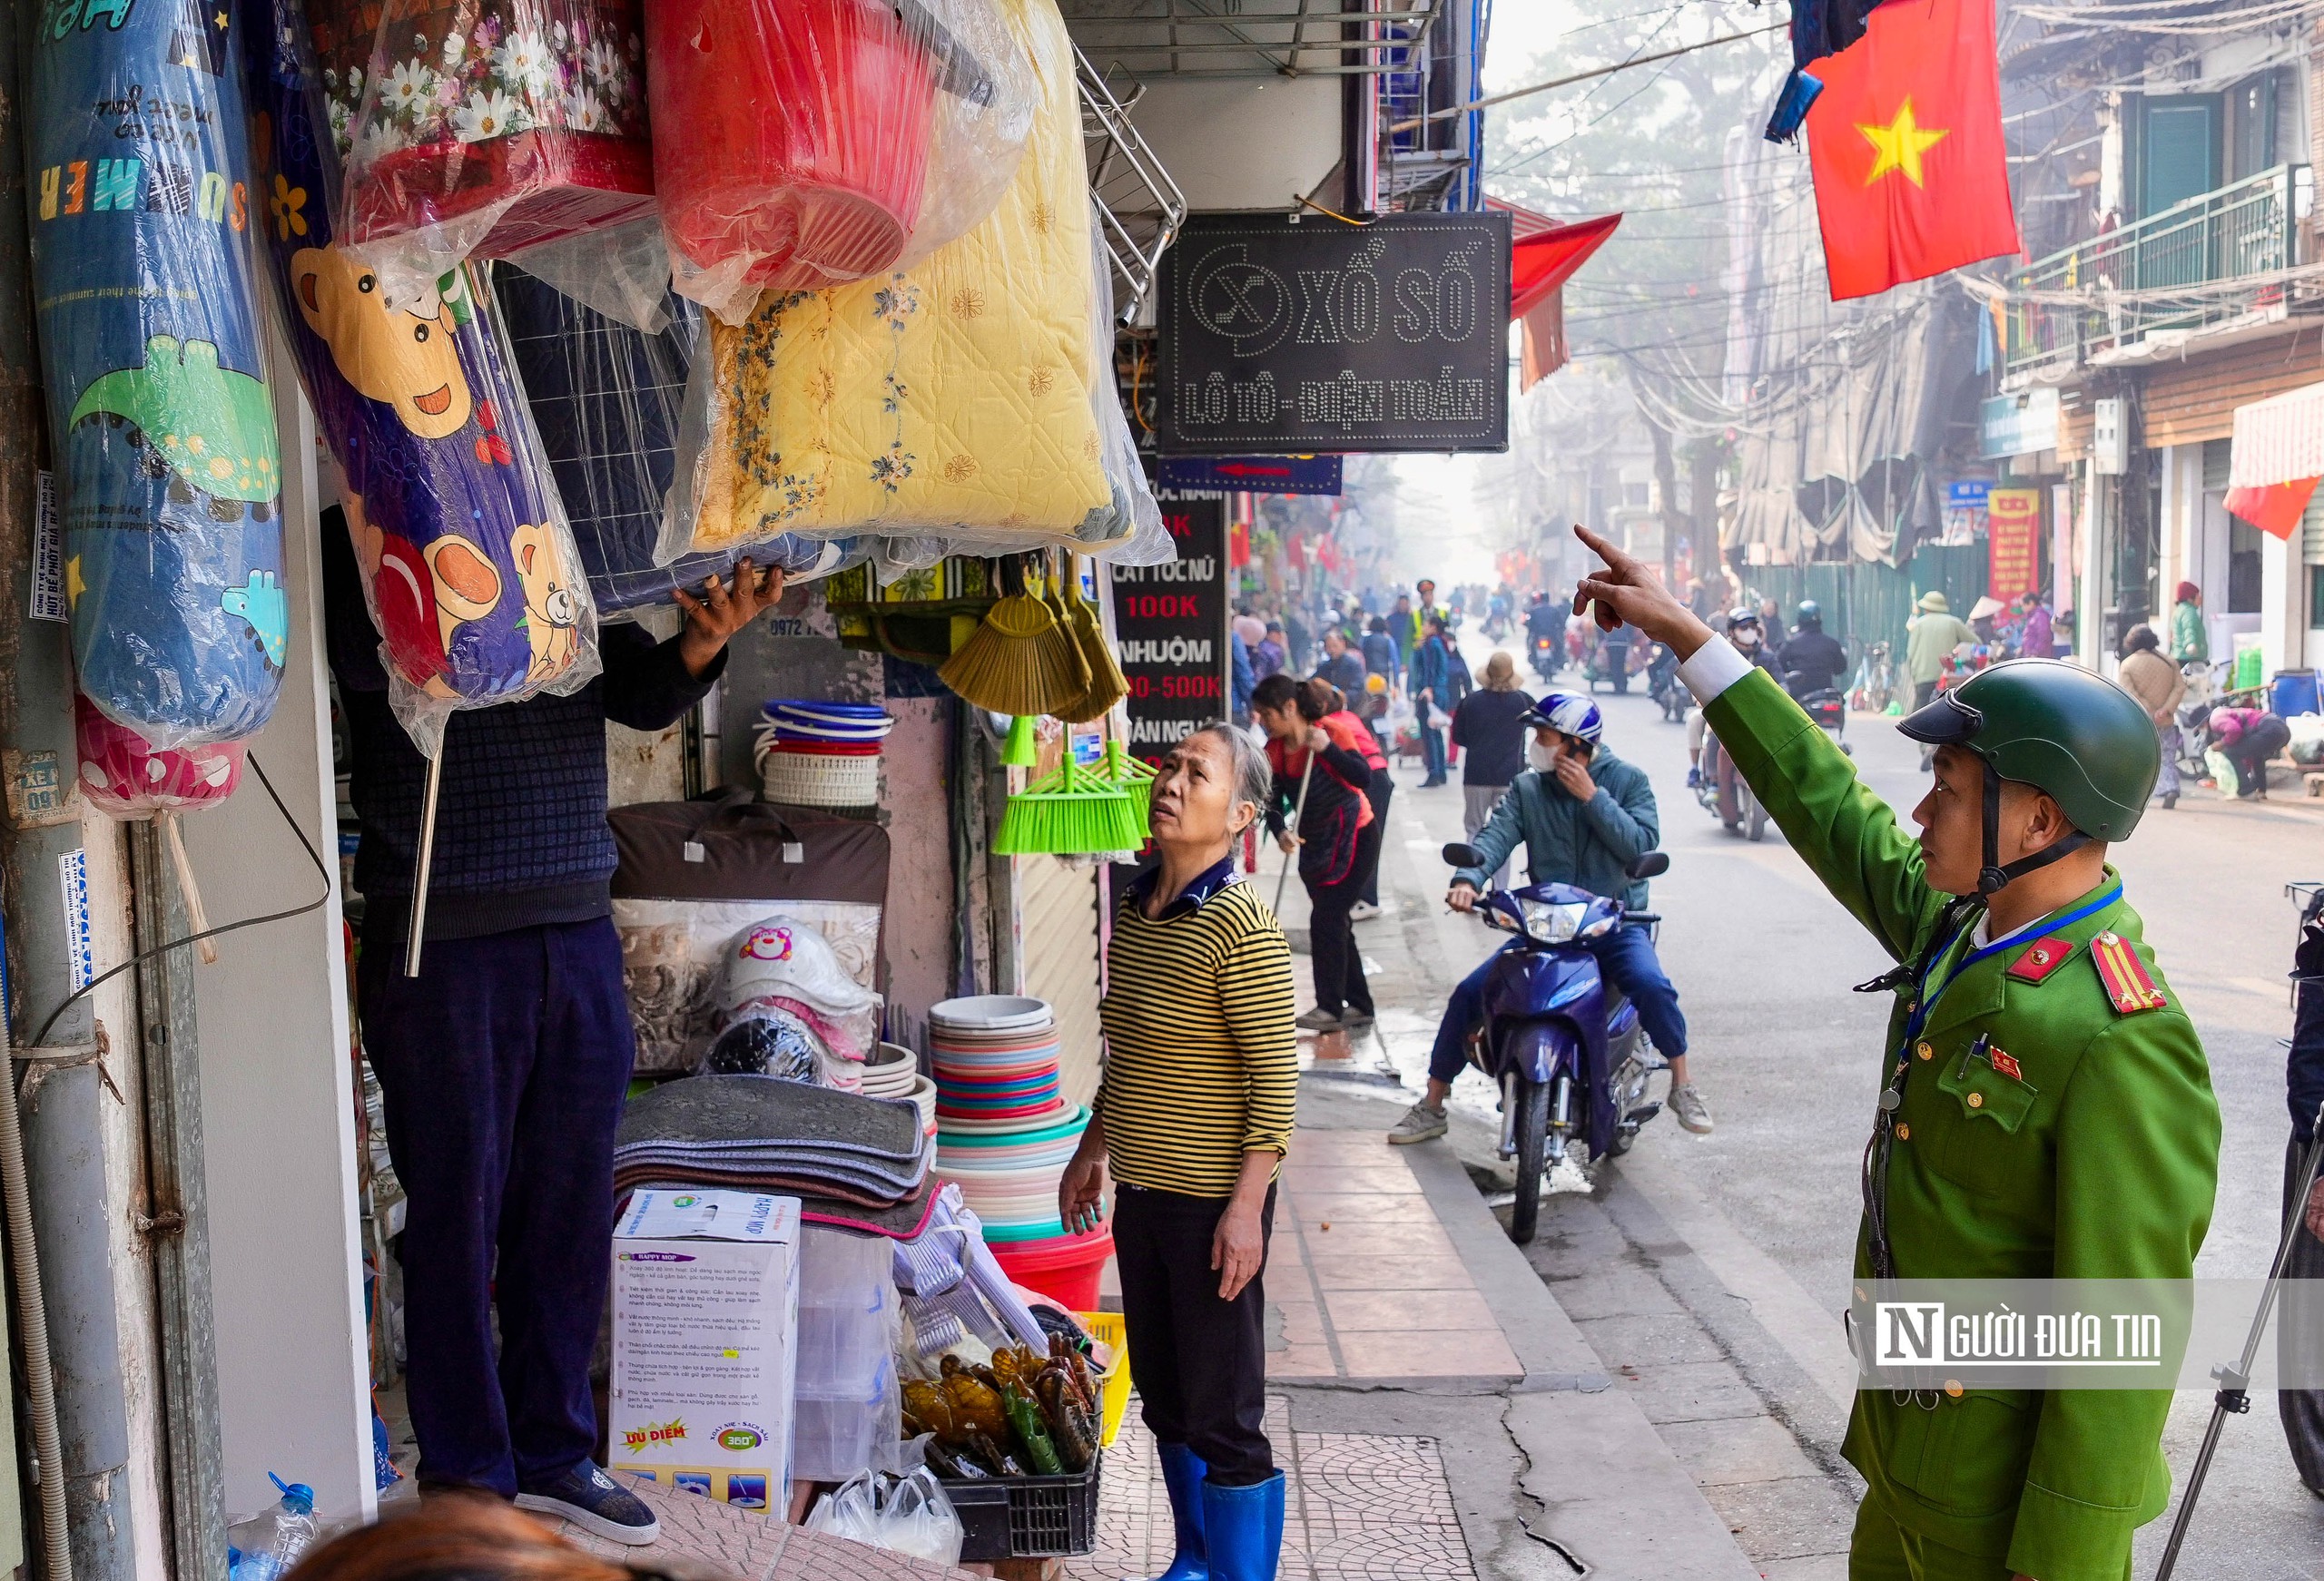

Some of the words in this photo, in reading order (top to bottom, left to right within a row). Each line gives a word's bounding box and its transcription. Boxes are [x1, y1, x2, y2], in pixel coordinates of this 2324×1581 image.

[39, 158, 248, 232] SUMMER
[1295, 237, 1387, 344] XỔ
[1393, 241, 1482, 343] SỐ
[1184, 370, 1228, 425] LÔ
[1232, 369, 1276, 424] TÔ
[1298, 368, 1384, 431] ĐIỆN
[1389, 365, 1484, 421] TOÁN
[47, 527, 59, 546] GIÁ
[47, 547, 59, 576] PHỐT
[38, 583, 45, 592] TY
[44, 576, 58, 593] BỂ
[45, 594, 58, 615] HÚT
[1126, 594, 1199, 618] 100K
[1118, 635, 1212, 667] NHUỘM
[750, 1197, 773, 1220] HAPPY
[626, 1430, 646, 1445] ƯU
[709, 1427, 724, 1441] XOAY
